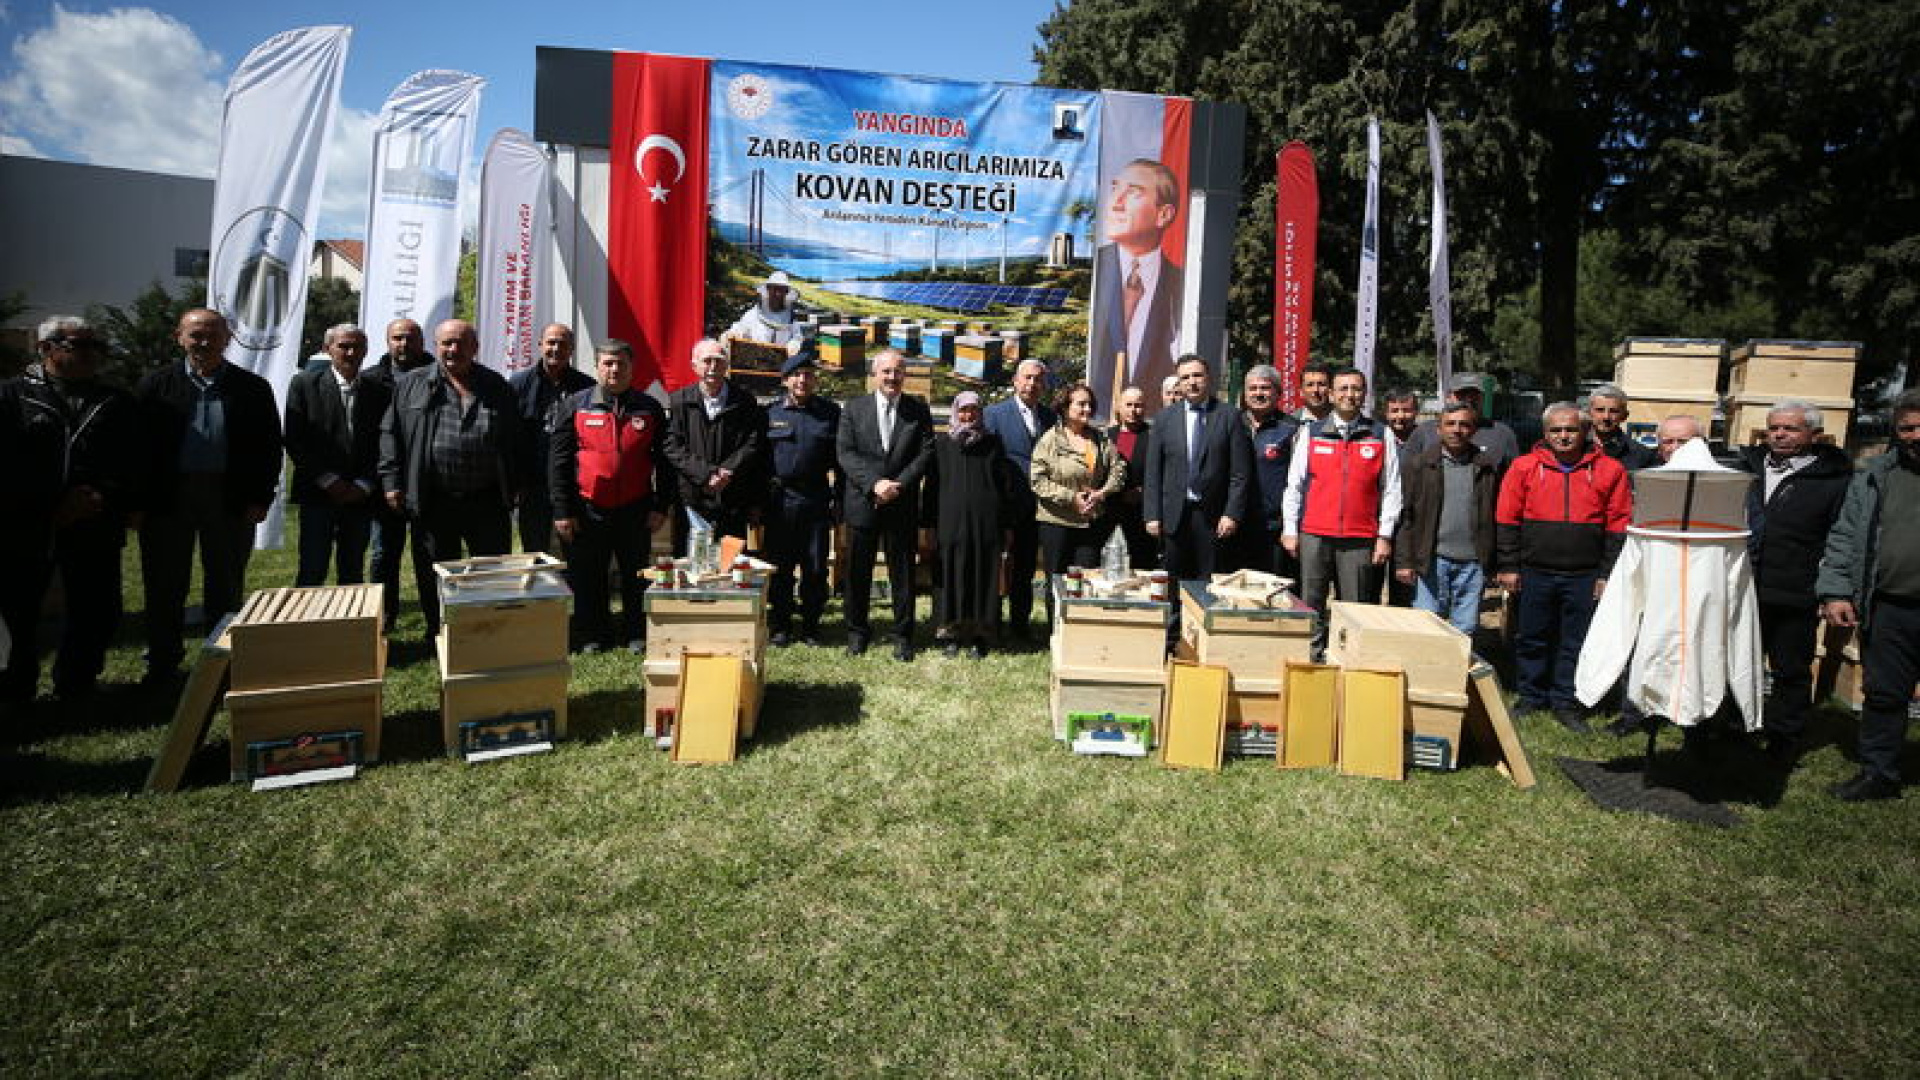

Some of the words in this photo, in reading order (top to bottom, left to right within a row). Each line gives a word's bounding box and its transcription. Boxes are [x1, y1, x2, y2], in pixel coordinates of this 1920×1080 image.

[853, 109, 967, 138] YANGINDA
[746, 136, 821, 162] ZARAR
[826, 139, 902, 168] GÖREN
[907, 148, 1065, 180] ARICILARIMIZA
[796, 172, 894, 205] KOVAN
[902, 181, 1016, 213] DESTEĞİ
